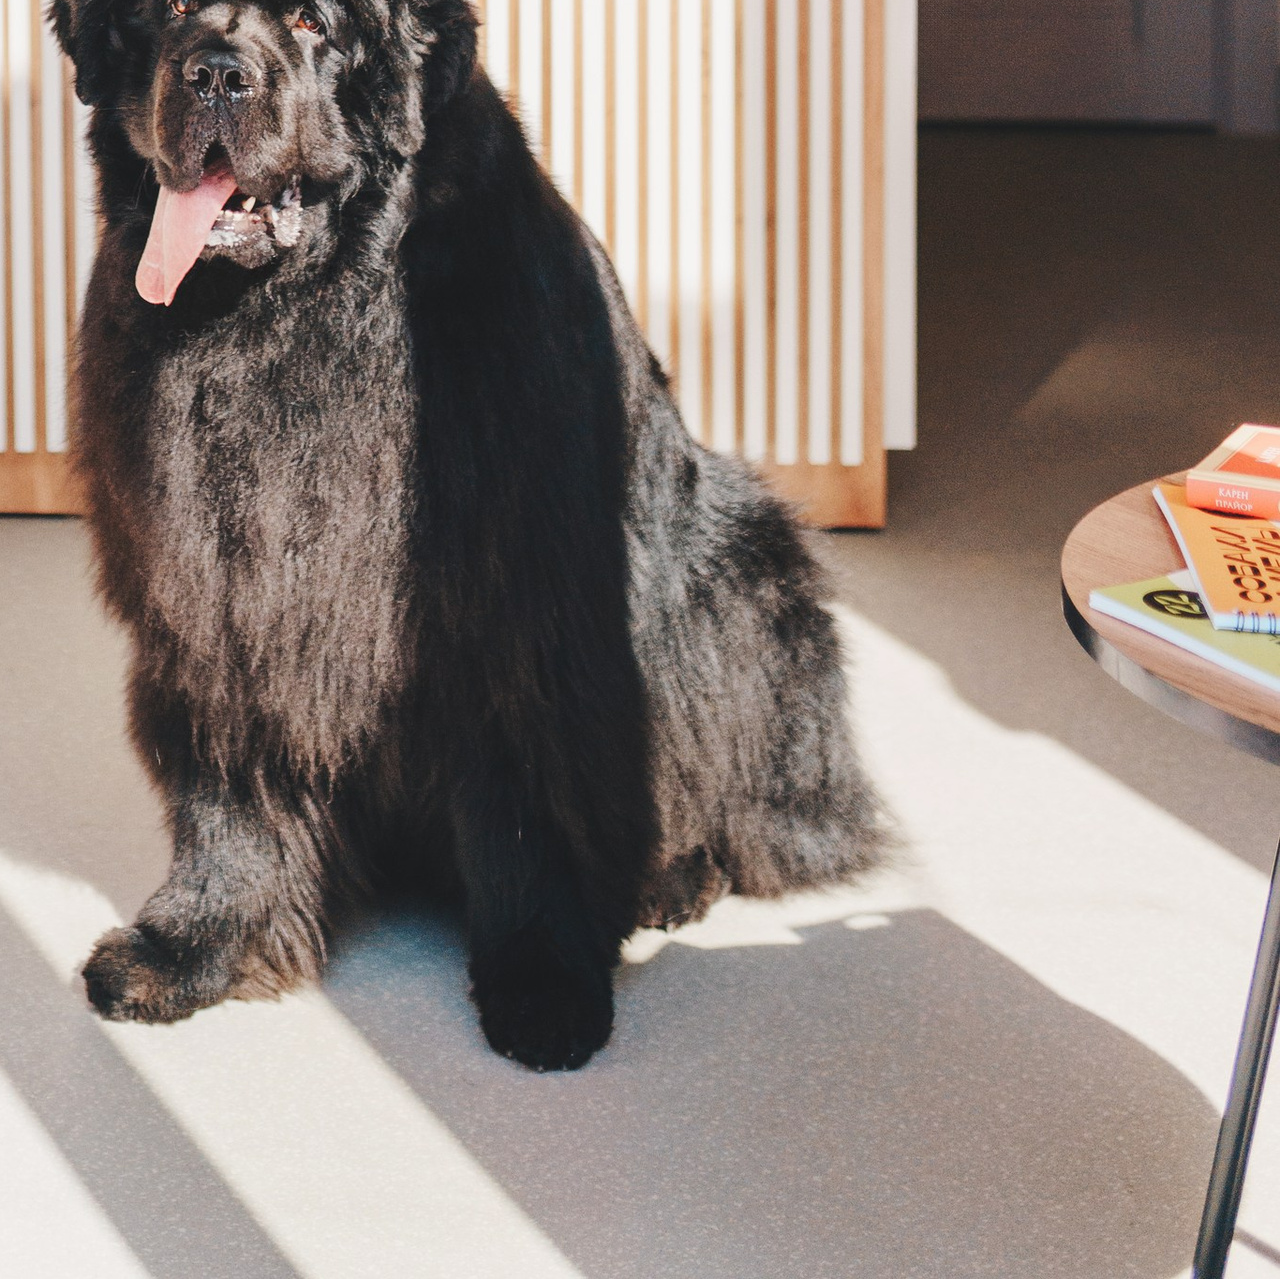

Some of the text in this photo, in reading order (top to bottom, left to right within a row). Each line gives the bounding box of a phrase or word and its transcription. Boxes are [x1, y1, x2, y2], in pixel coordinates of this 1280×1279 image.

[1218, 487, 1249, 501] КАРЕН
[1215, 499, 1253, 512] ПРАЙОР
[1210, 526, 1273, 603] СОБАКИ
